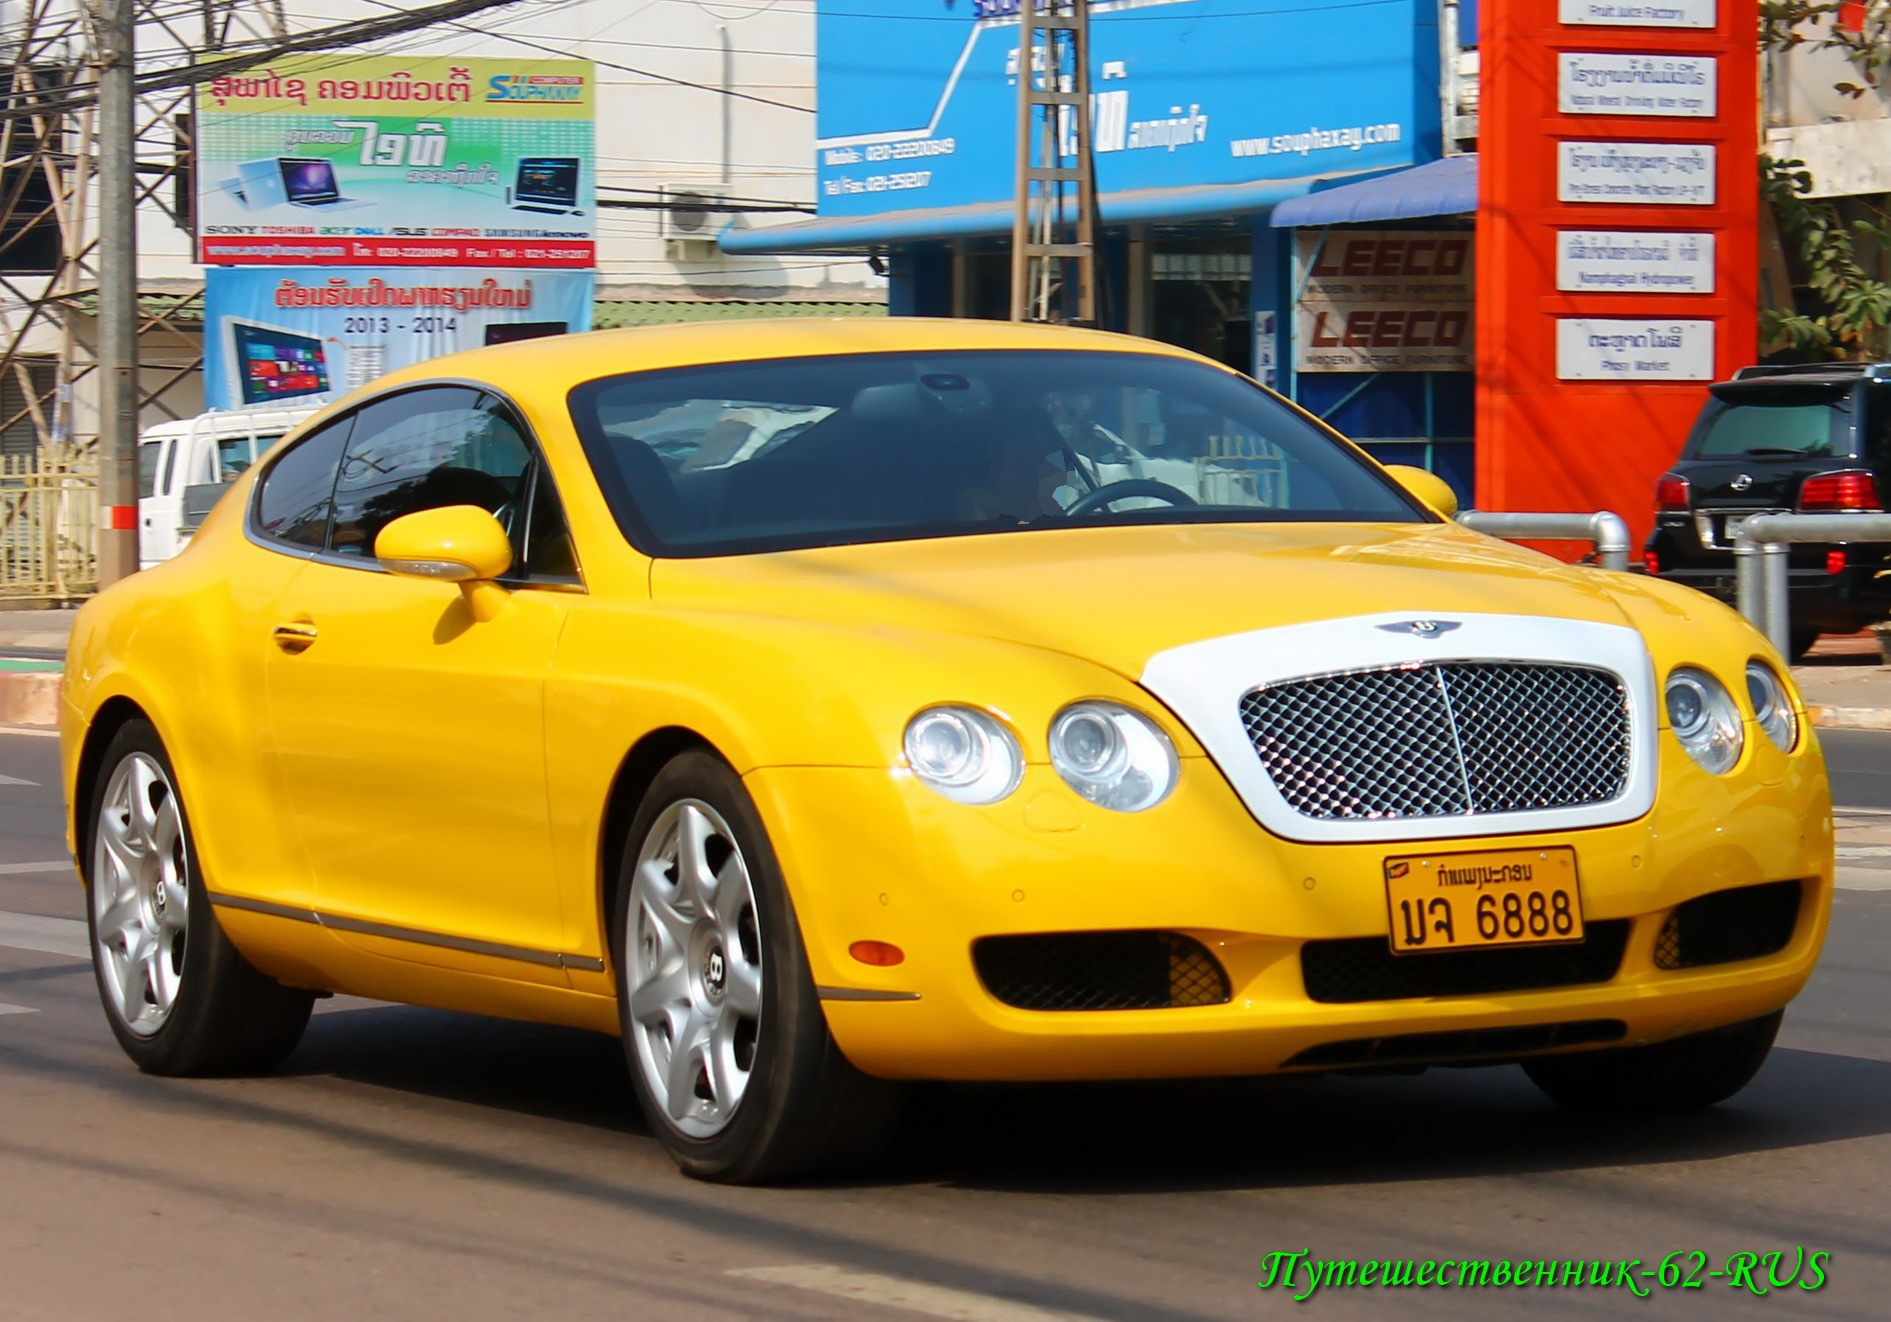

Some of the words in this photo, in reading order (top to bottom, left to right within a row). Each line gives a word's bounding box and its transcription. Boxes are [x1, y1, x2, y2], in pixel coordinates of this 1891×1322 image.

[1645, 7, 1685, 21] Factory
[1230, 123, 1400, 157] www.souphaxay.com
[205, 226, 257, 235] SONY
[260, 226, 315, 235] TOSHIBA
[354, 227, 385, 236] DELL
[1311, 239, 1468, 277] LEECO
[344, 317, 391, 334] 2013
[411, 317, 458, 334] 2014
[1311, 311, 1469, 348] LEECO
[1306, 355, 1354, 366] MODERN
[1361, 355, 1400, 366] OFFICE
[1405, 355, 1468, 365] FURNITURE
[1475, 888, 1574, 941] 6888
